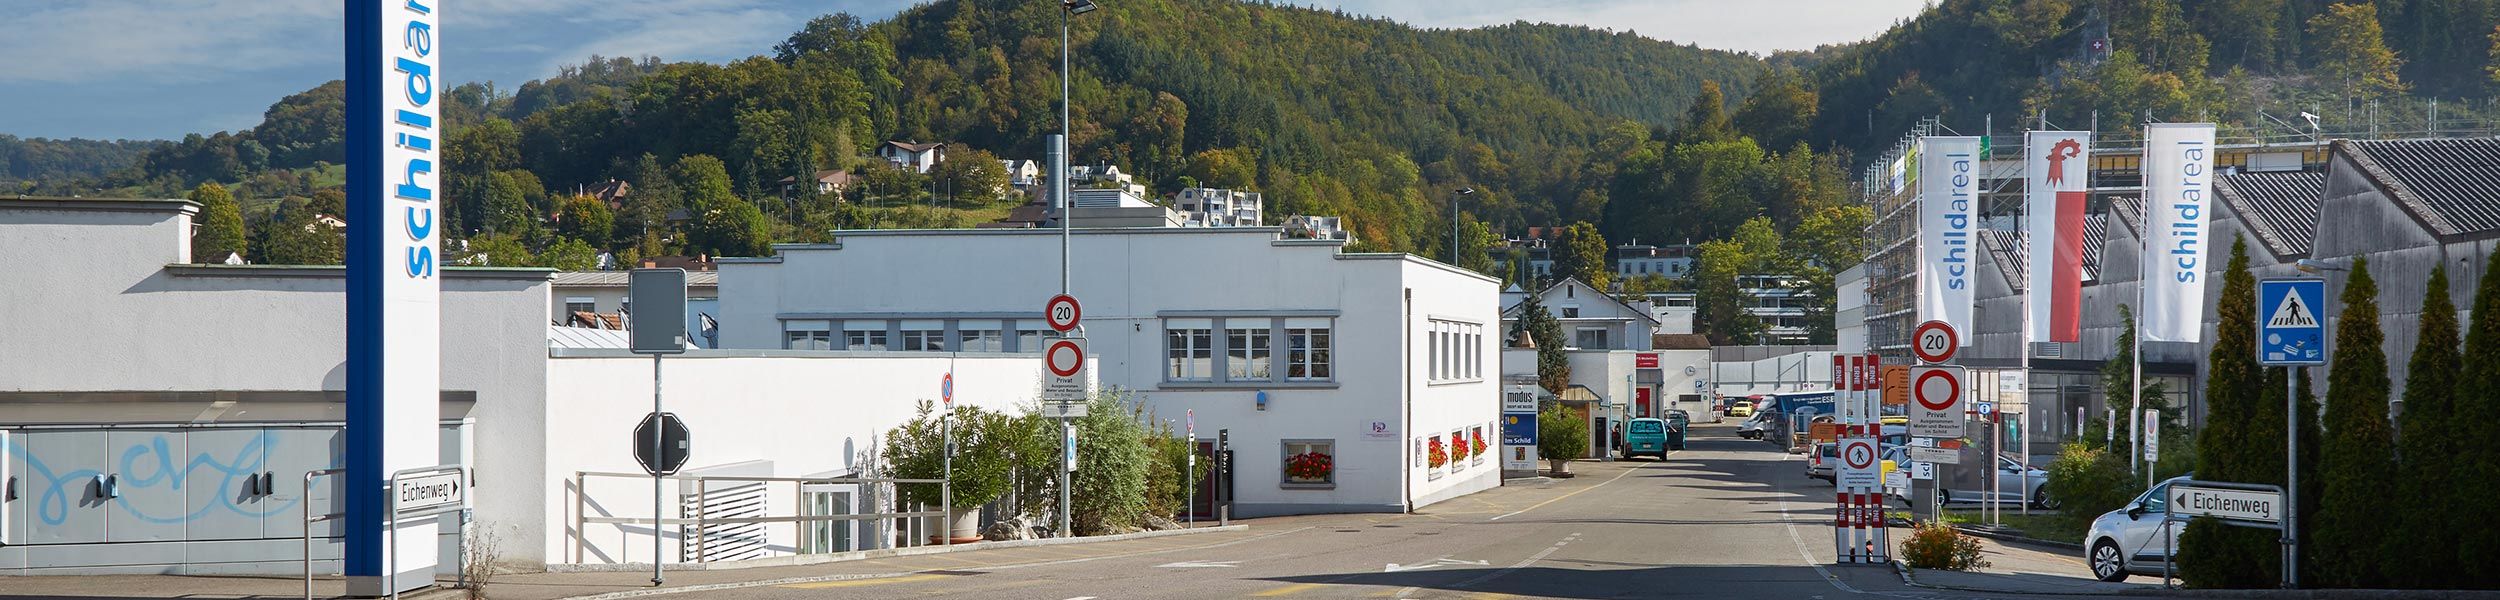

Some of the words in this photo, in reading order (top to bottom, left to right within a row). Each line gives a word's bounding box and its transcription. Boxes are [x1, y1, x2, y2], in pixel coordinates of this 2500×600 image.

[1943, 153, 1970, 290] schildareal
[2171, 141, 2204, 283] schildareal
[1056, 306, 1071, 320] 20
[1925, 334, 1945, 350] 20
[1868, 365, 1876, 385] ERNE
[1507, 391, 1533, 403] modus
[402, 482, 448, 502] Eichenweg
[2194, 492, 2269, 518] Eichenweg
